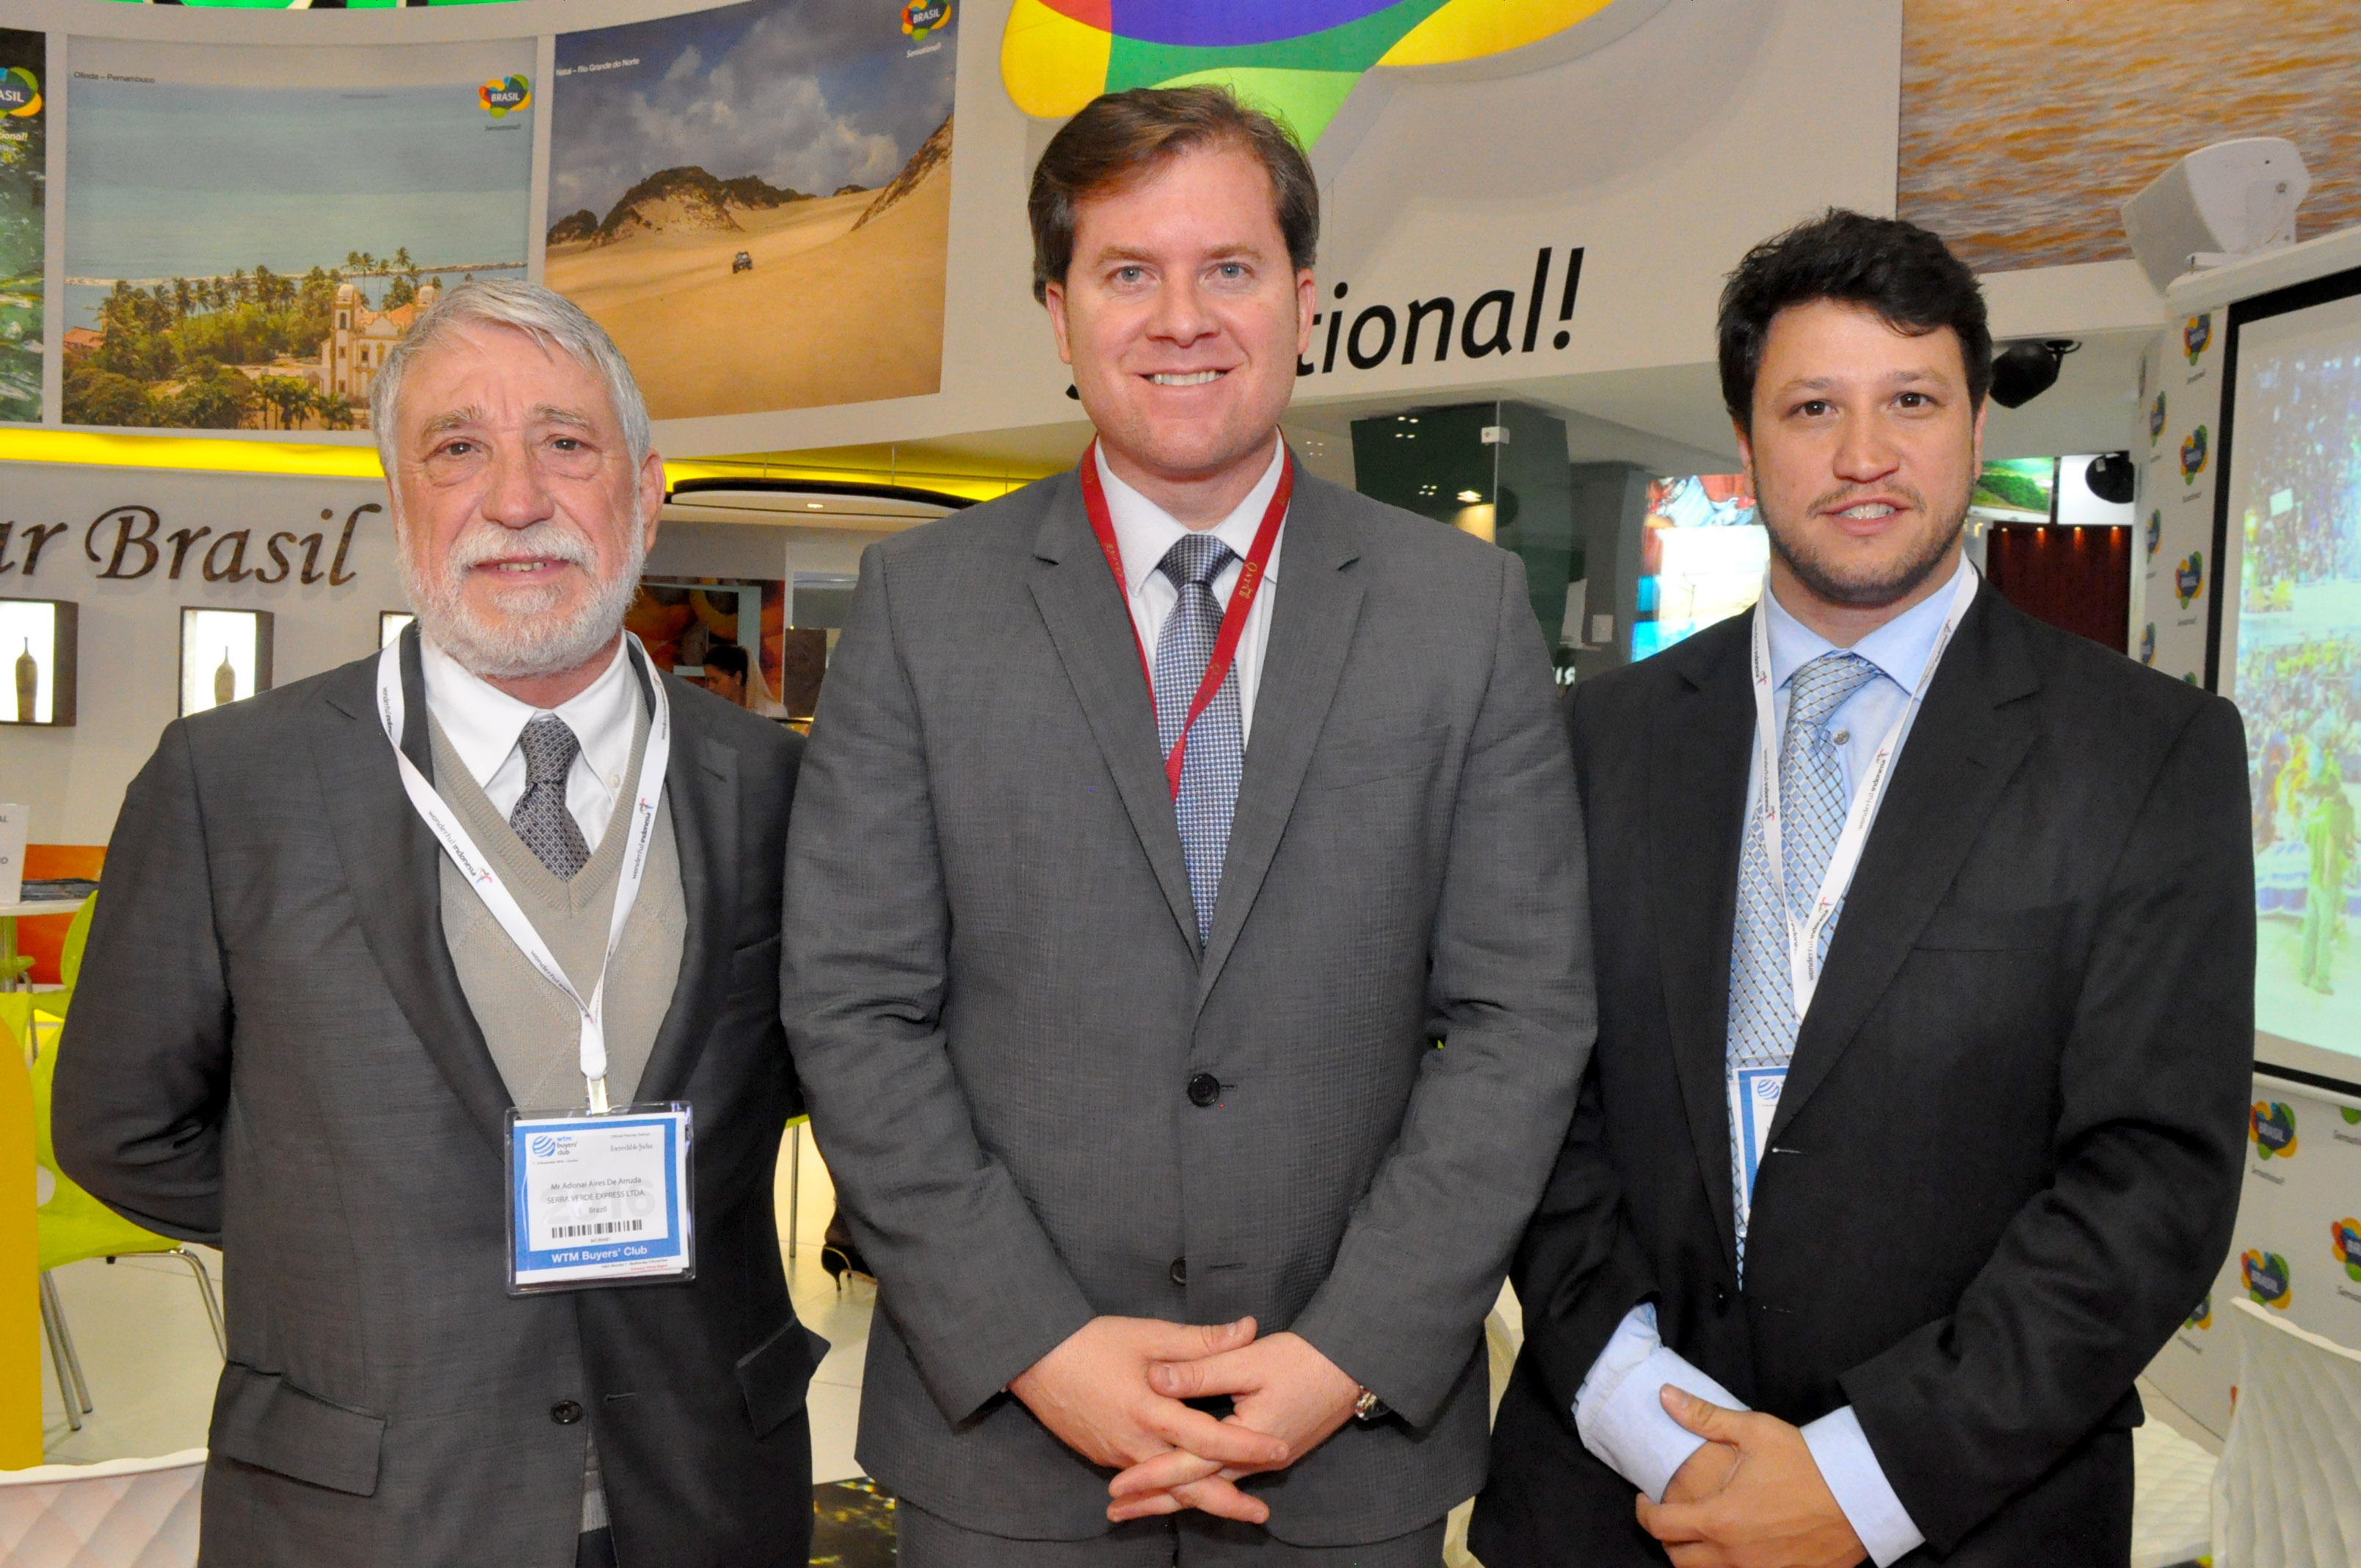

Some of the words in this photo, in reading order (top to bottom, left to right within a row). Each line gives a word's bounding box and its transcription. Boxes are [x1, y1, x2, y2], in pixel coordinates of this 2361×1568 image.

[913, 8, 940, 23] BRASIL
[590, 62, 612, 71] Grande
[623, 58, 639, 67] Norte
[74, 71, 99, 80] Olinda
[107, 73, 156, 83] Pernambuco
[491, 92, 520, 102] BRASIL
[84, 503, 382, 586] Brasil
[429, 810, 457, 846] wonderful
[632, 843, 645, 879] wonderful
[562, 1180, 587, 1189] Adonai
[618, 1176, 642, 1185] Arruda
[571, 1193, 594, 1202] VERDE
[595, 1191, 625, 1199] EXPRESS
[589, 1205, 607, 1214] Brazil
[551, 1252, 579, 1263] WTM
[624, 1245, 648, 1257] Club
